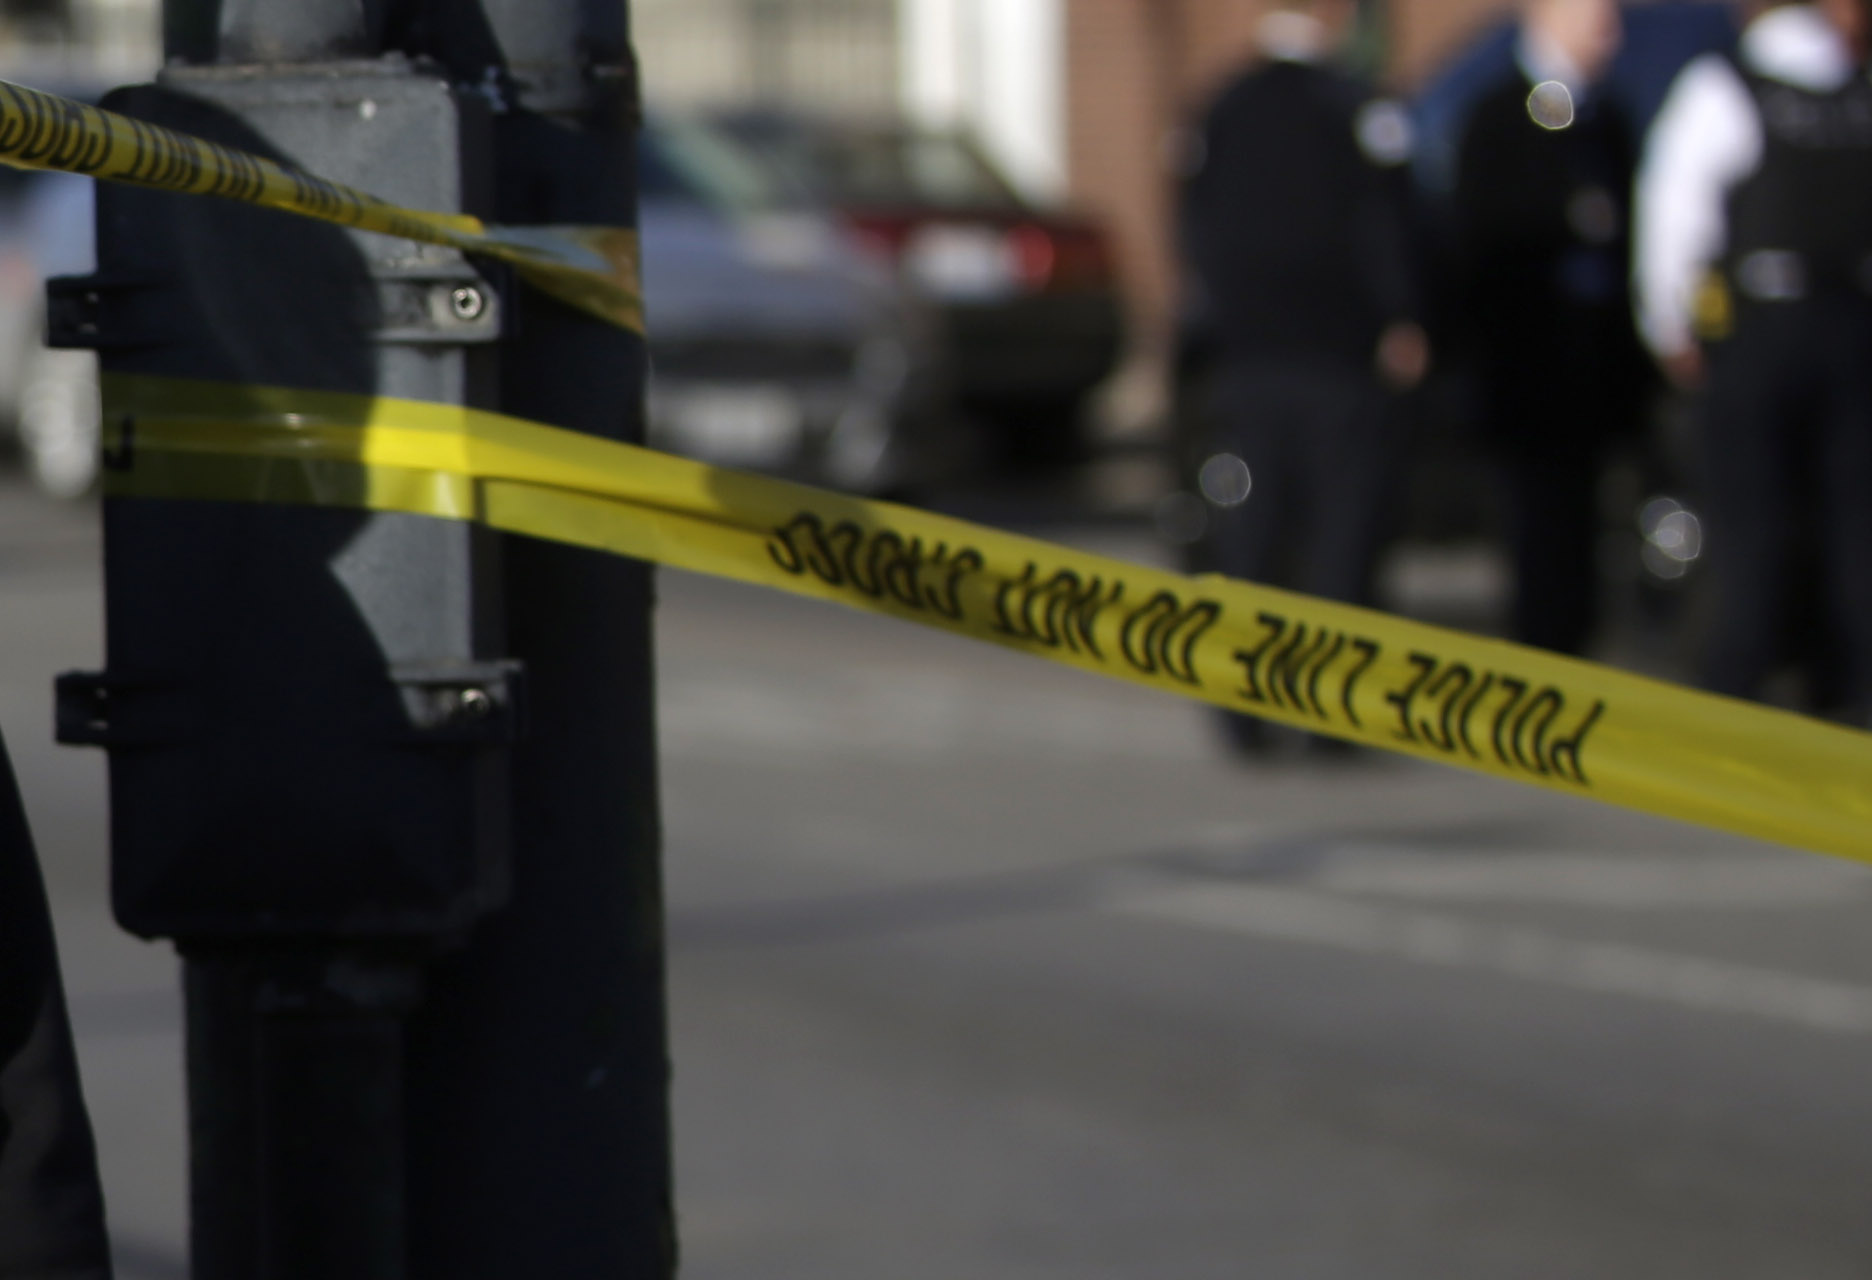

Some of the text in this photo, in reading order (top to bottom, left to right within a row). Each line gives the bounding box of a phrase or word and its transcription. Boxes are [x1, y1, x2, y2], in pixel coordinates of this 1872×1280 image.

[994, 557, 1128, 664] NOT
[1119, 589, 1223, 687] DO
[1230, 610, 1383, 730] LINE
[1384, 652, 1606, 787] POLICE
